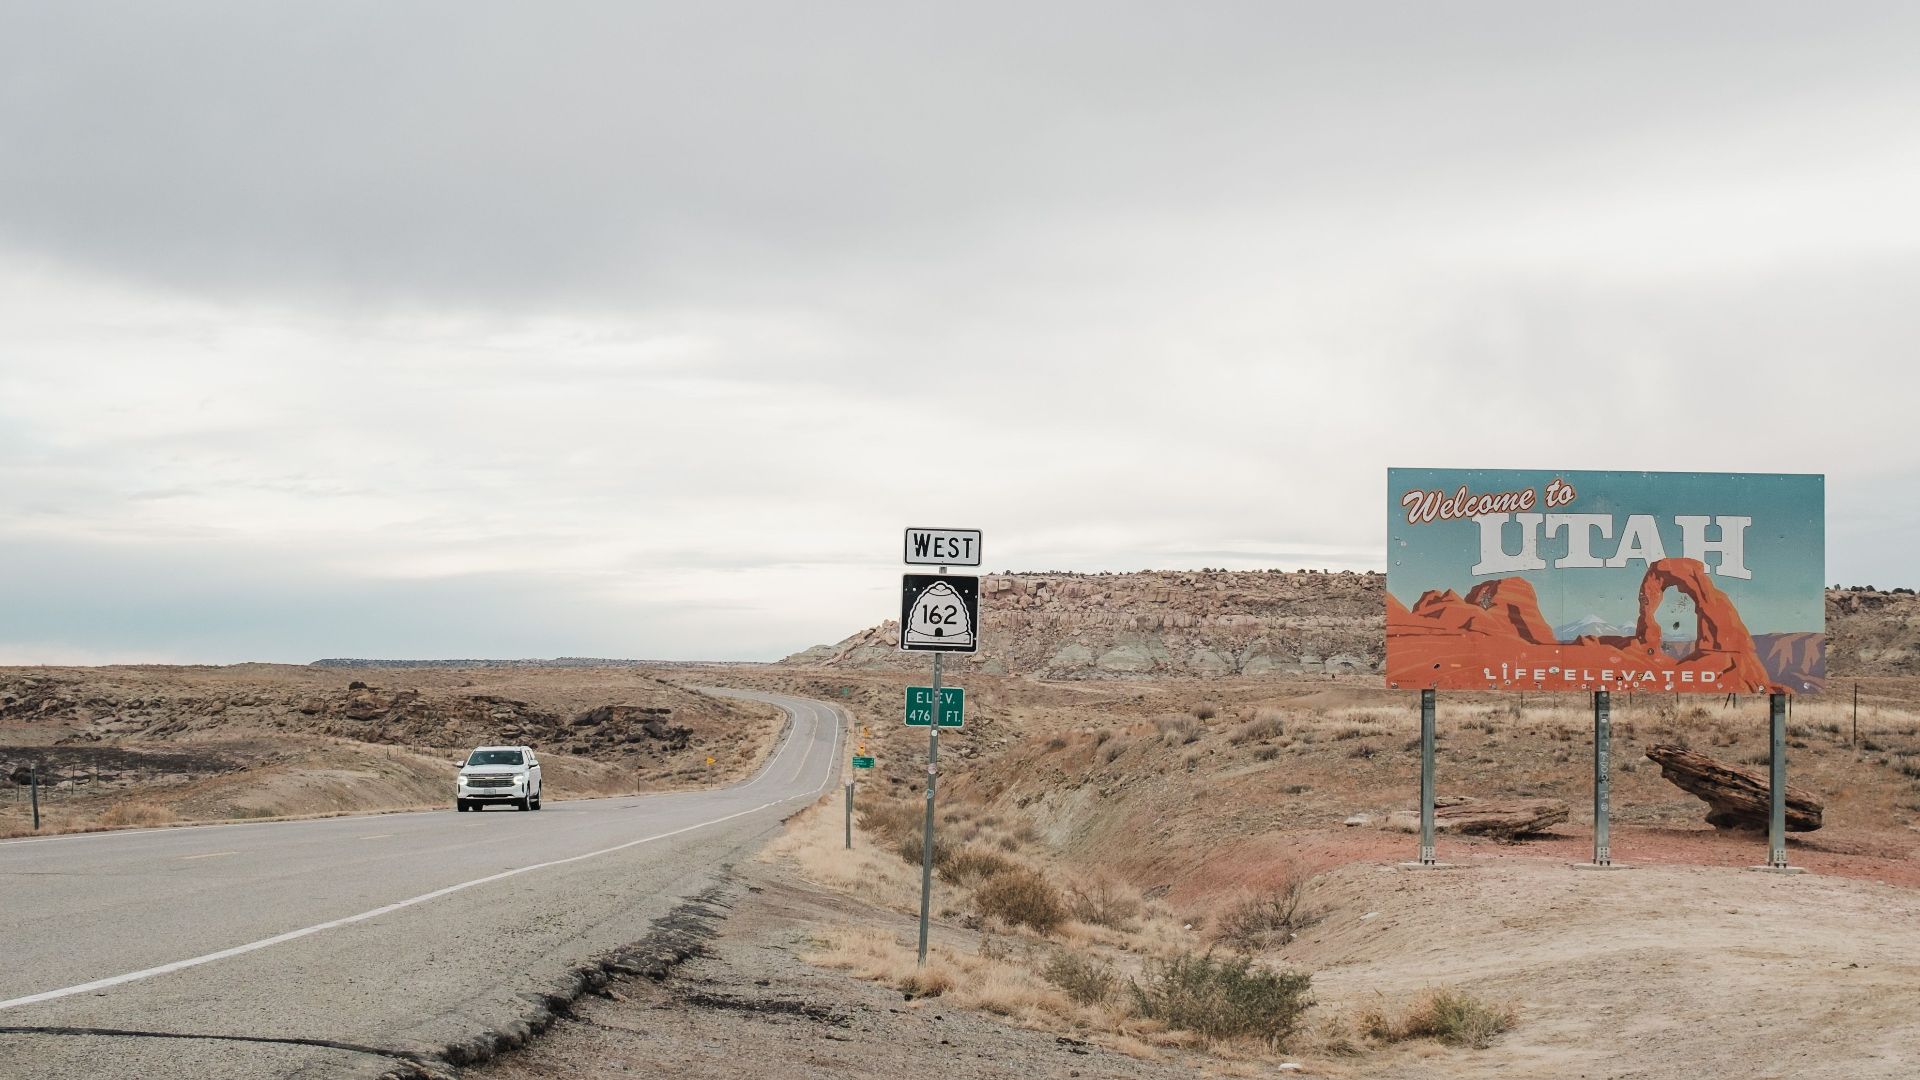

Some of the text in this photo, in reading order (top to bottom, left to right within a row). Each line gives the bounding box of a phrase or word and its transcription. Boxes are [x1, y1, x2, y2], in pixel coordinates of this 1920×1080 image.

[1402, 479, 1576, 524] Welcome to
[913, 533, 974, 558] WEST
[1471, 513, 1752, 580] UTAH
[922, 604, 957, 625] 162
[1485, 668, 1716, 682] LIFE ELEVATED
[909, 709, 961, 722] 476 FT.
